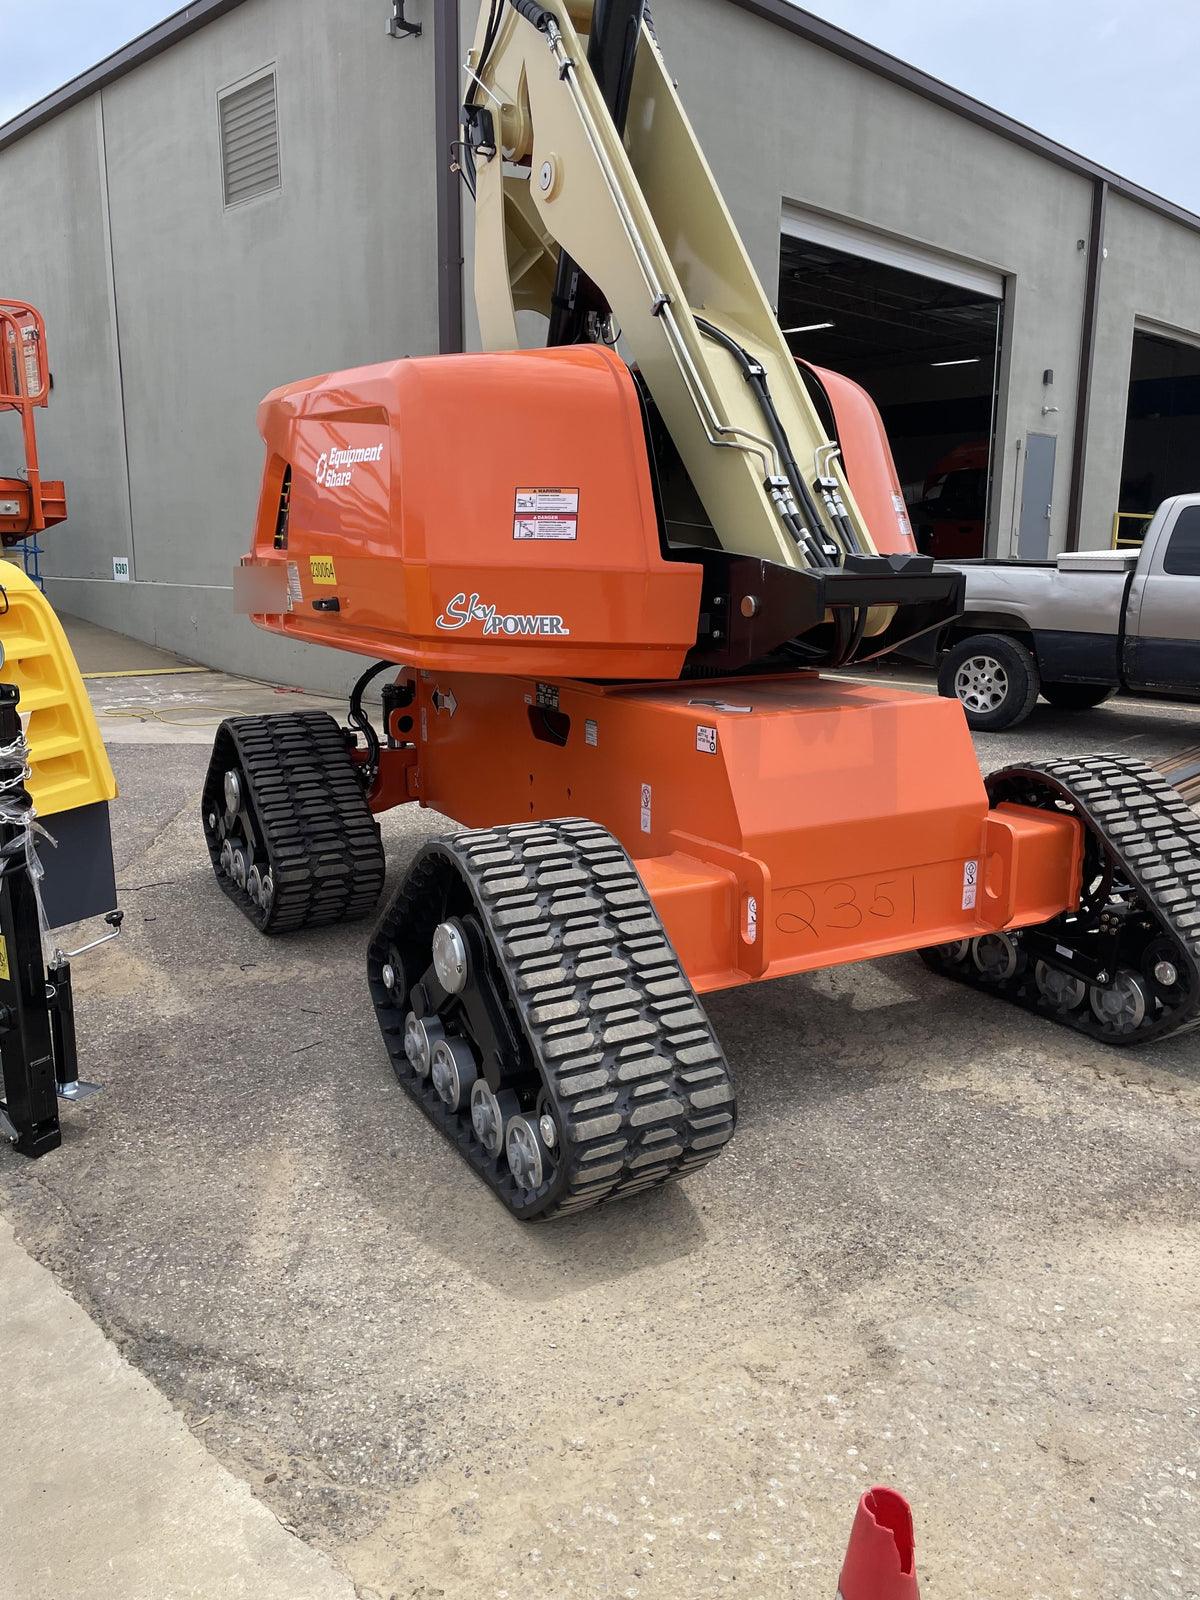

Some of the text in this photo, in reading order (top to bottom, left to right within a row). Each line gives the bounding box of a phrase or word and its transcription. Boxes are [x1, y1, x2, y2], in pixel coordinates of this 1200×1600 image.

[328, 443, 383, 469] Equipment
[325, 469, 352, 488] Share
[775, 874, 916, 938] 2351
